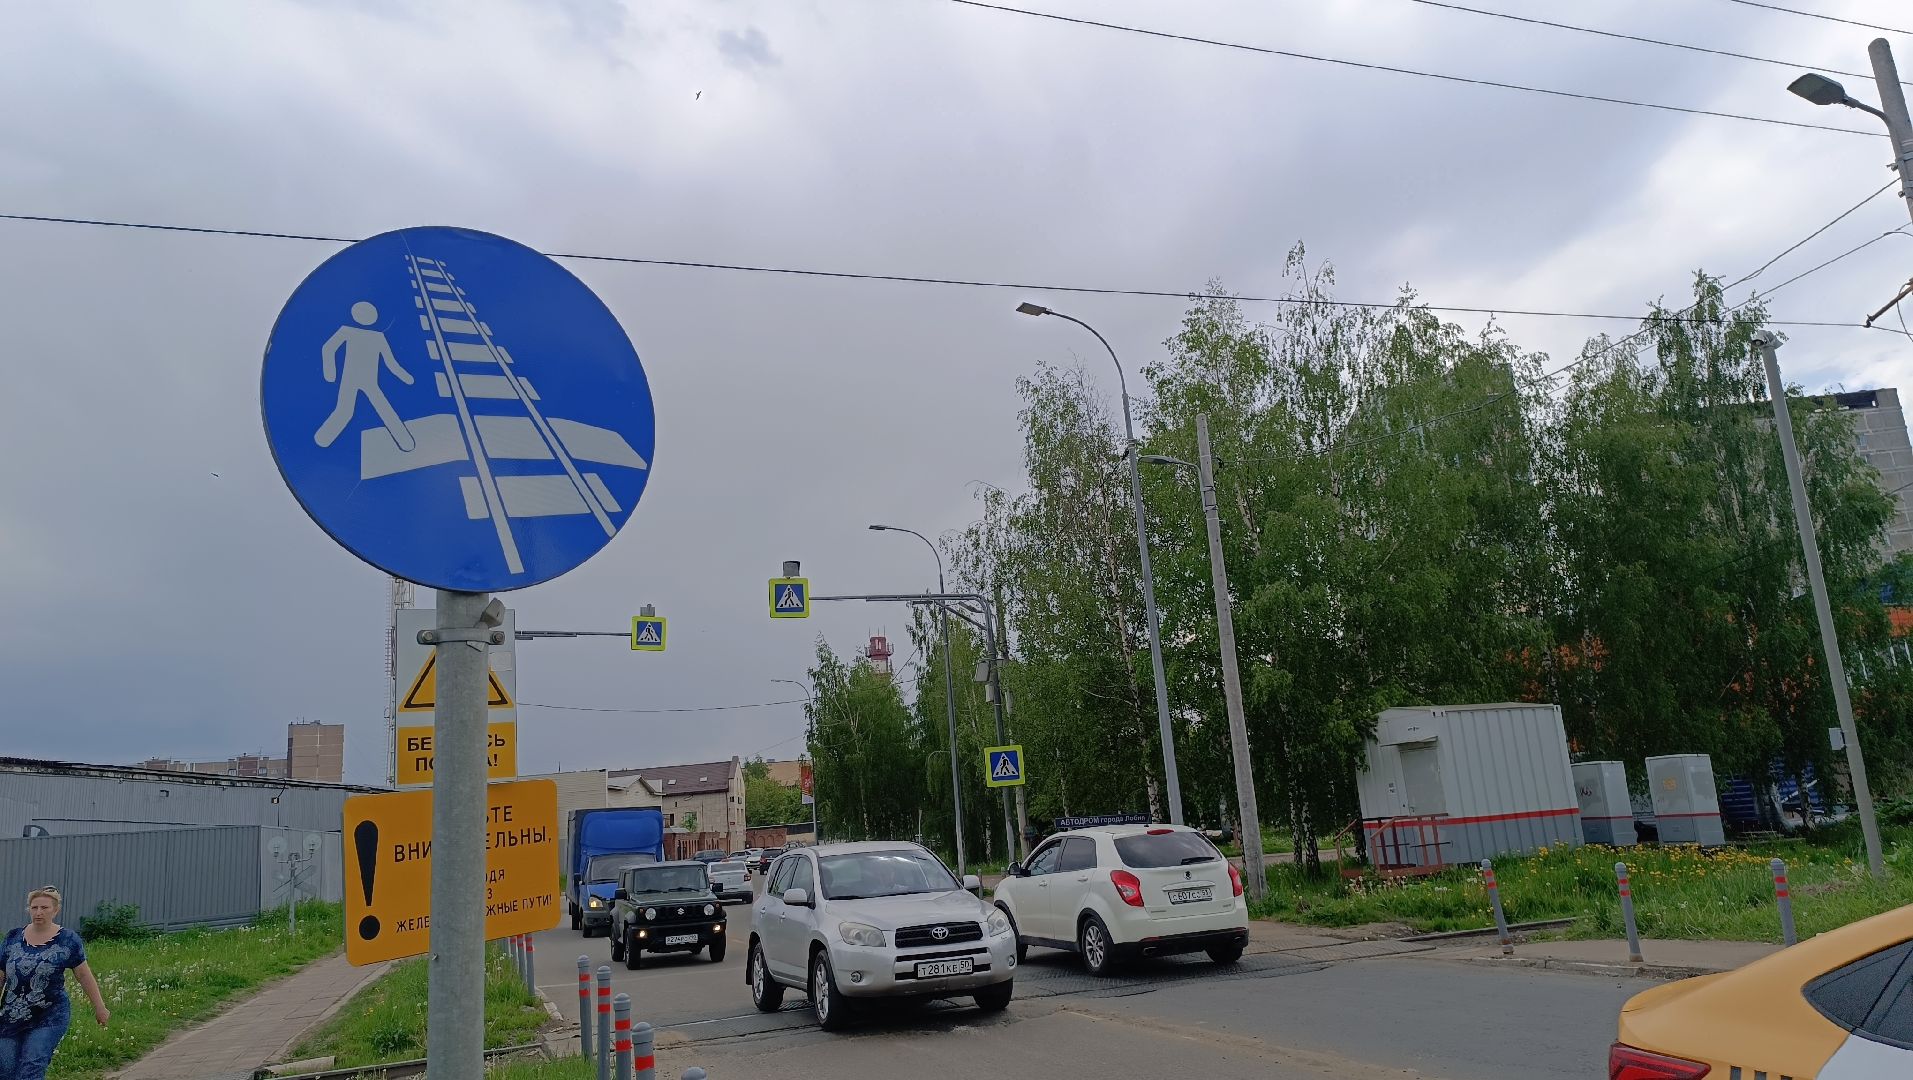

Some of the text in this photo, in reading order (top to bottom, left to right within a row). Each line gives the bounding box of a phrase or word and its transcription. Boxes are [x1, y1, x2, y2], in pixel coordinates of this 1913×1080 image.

[1060, 817, 1100, 826] АВТОДРОМ
[1100, 816, 1123, 825] города
[522, 894, 552, 910] ПУТИ!
